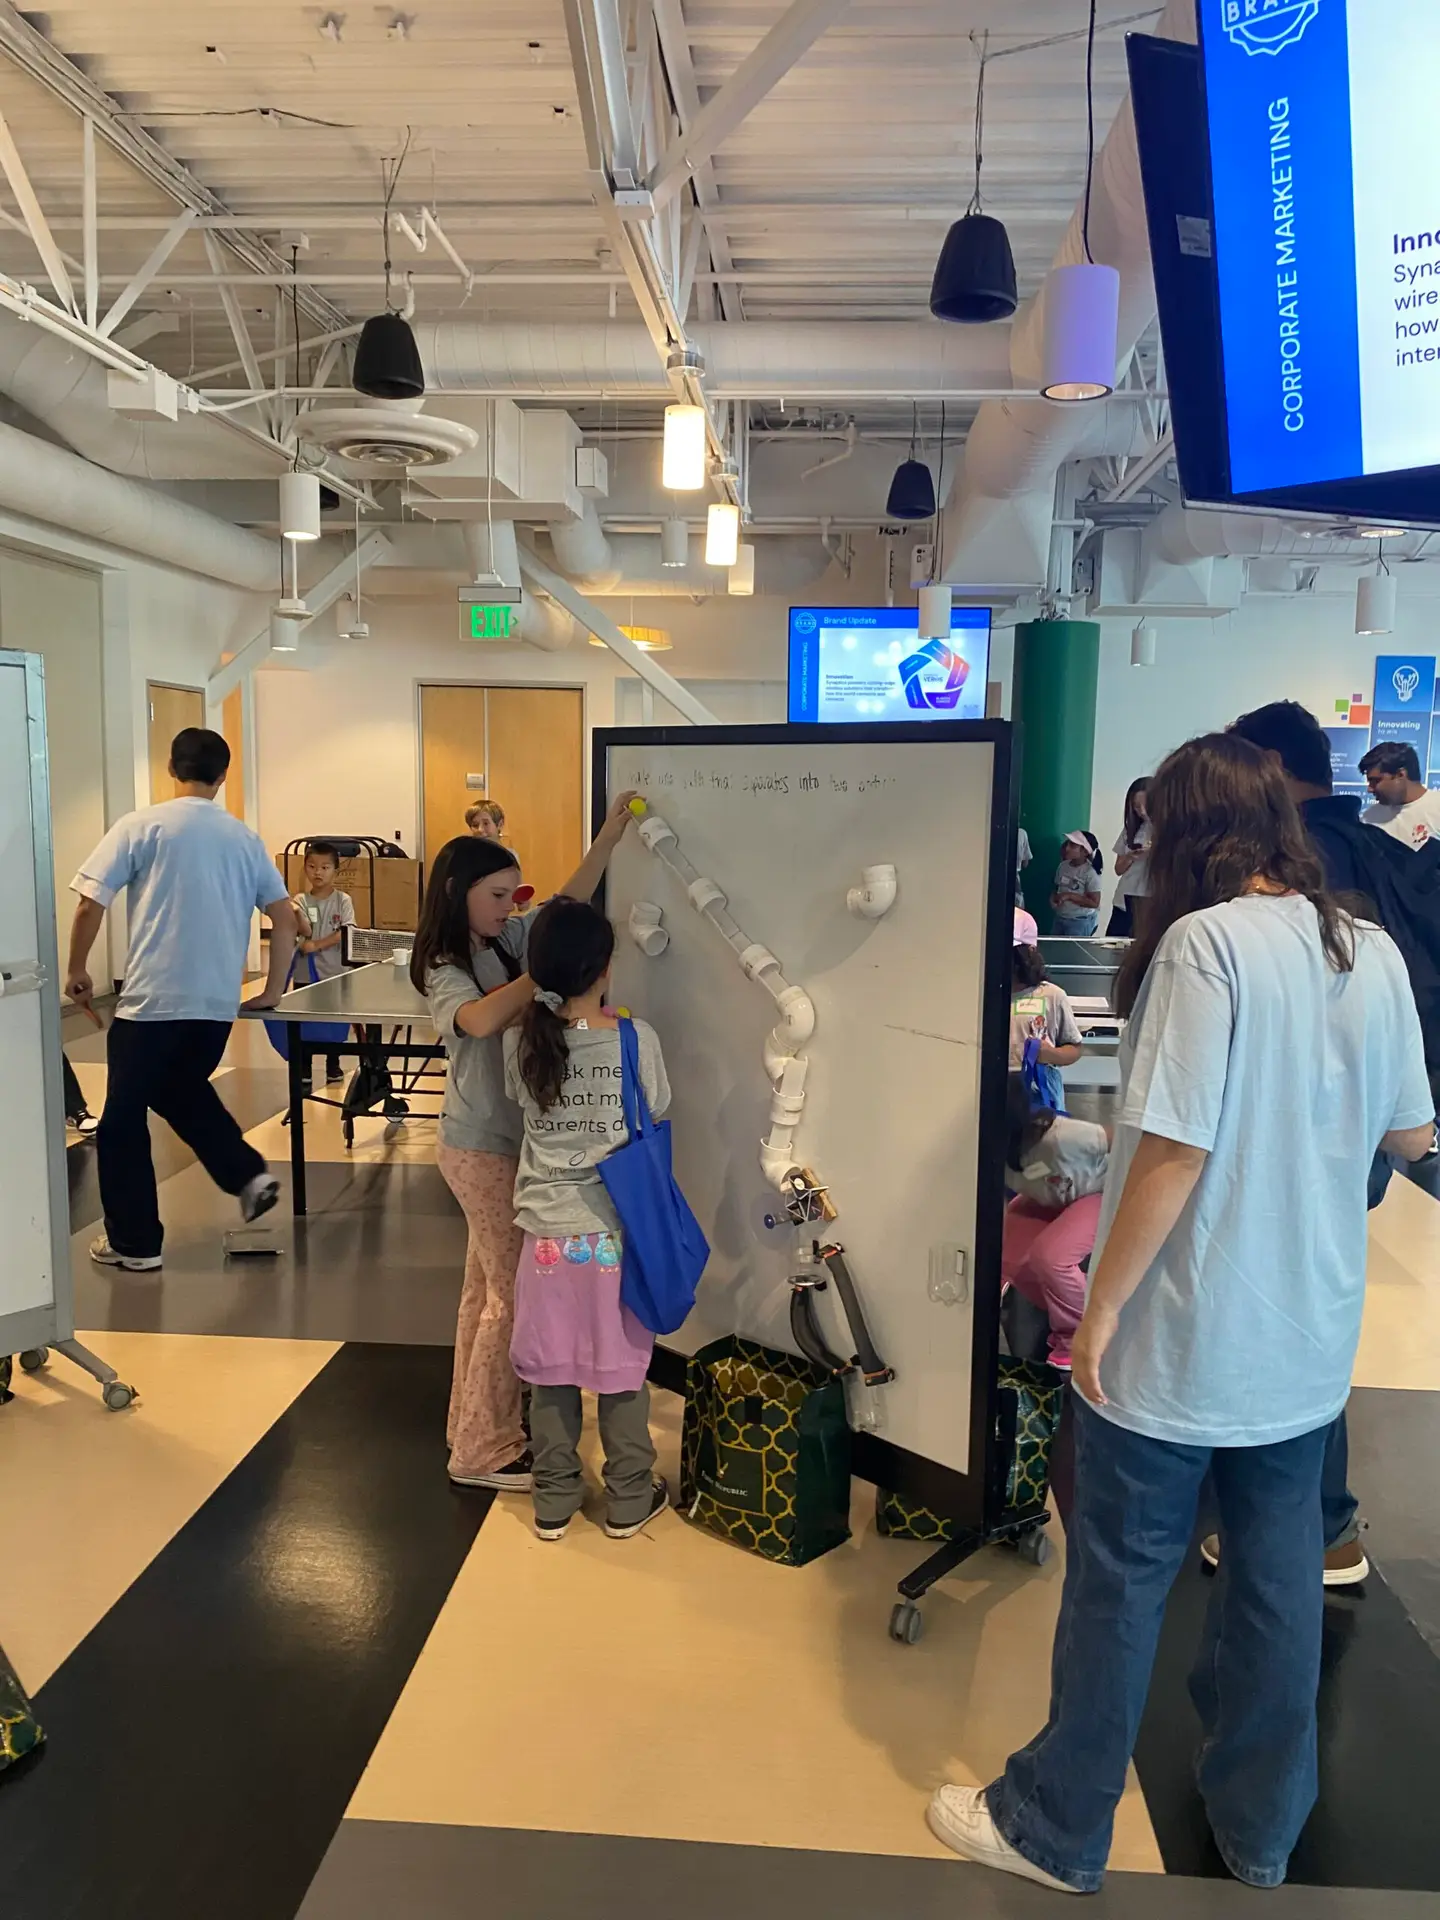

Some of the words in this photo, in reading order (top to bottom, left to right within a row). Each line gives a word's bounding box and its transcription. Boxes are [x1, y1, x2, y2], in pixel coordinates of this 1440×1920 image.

[1227, 0, 1290, 22] BRA
[1268, 96, 1298, 267] MARKETING
[1393, 260, 1440, 285] Syna
[1394, 289, 1438, 311] wire
[1395, 318, 1439, 339] how
[1276, 269, 1304, 433] CORPORATE
[471, 604, 512, 638] EXIT
[824, 617, 847, 625] Brand
[848, 617, 877, 627] Update
[1378, 720, 1421, 731] Innovating
[799, 771, 820, 792] into
[561, 1063, 585, 1081] sk
[592, 1066, 622, 1078] me
[600, 1093, 624, 1109] my
[534, 1118, 607, 1134] parents
